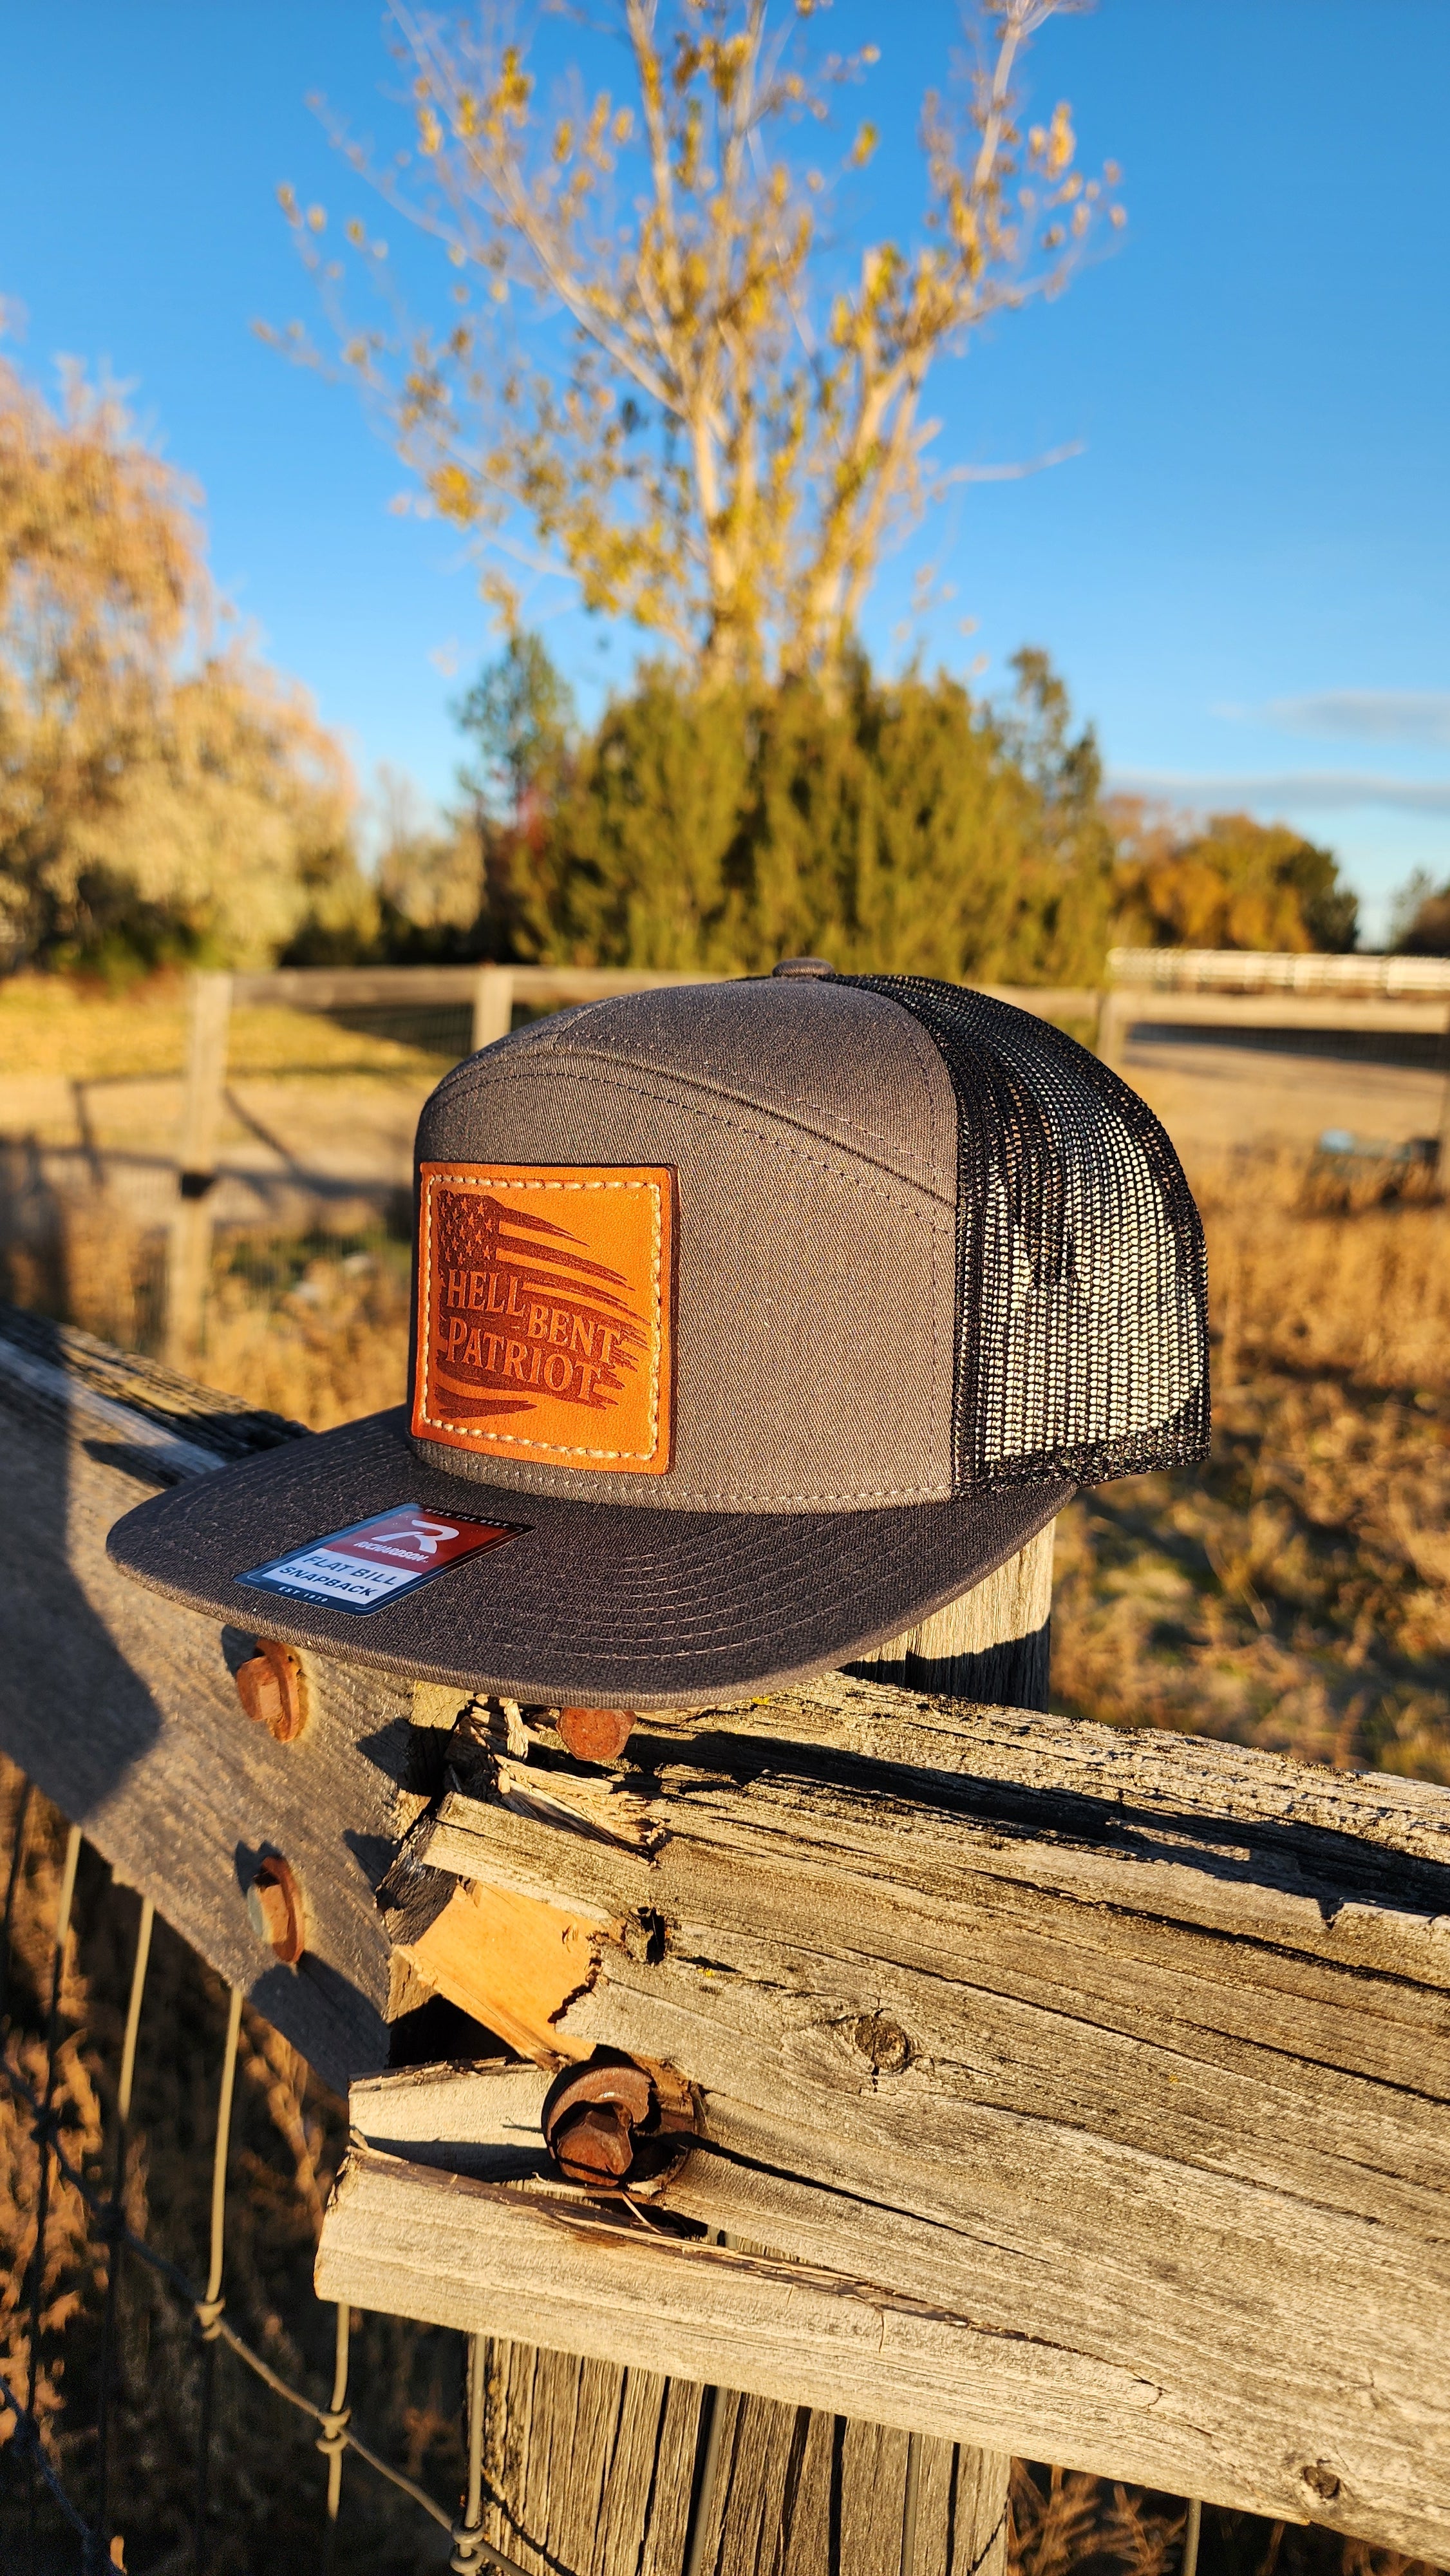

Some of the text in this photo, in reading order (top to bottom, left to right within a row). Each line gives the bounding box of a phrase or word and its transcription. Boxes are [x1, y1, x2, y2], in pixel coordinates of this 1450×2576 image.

[447, 1269, 622, 1365] HELL BENT
[447, 1316, 602, 1402] PATRIOT
[424, 1508, 452, 1517] WEAR
[353, 1541, 429, 1562] RICHARDSON
[279, 1566, 379, 1596] SNAPBACK
[302, 1556, 399, 1586] FLAT BILL
[278, 1586, 301, 1595] EST
